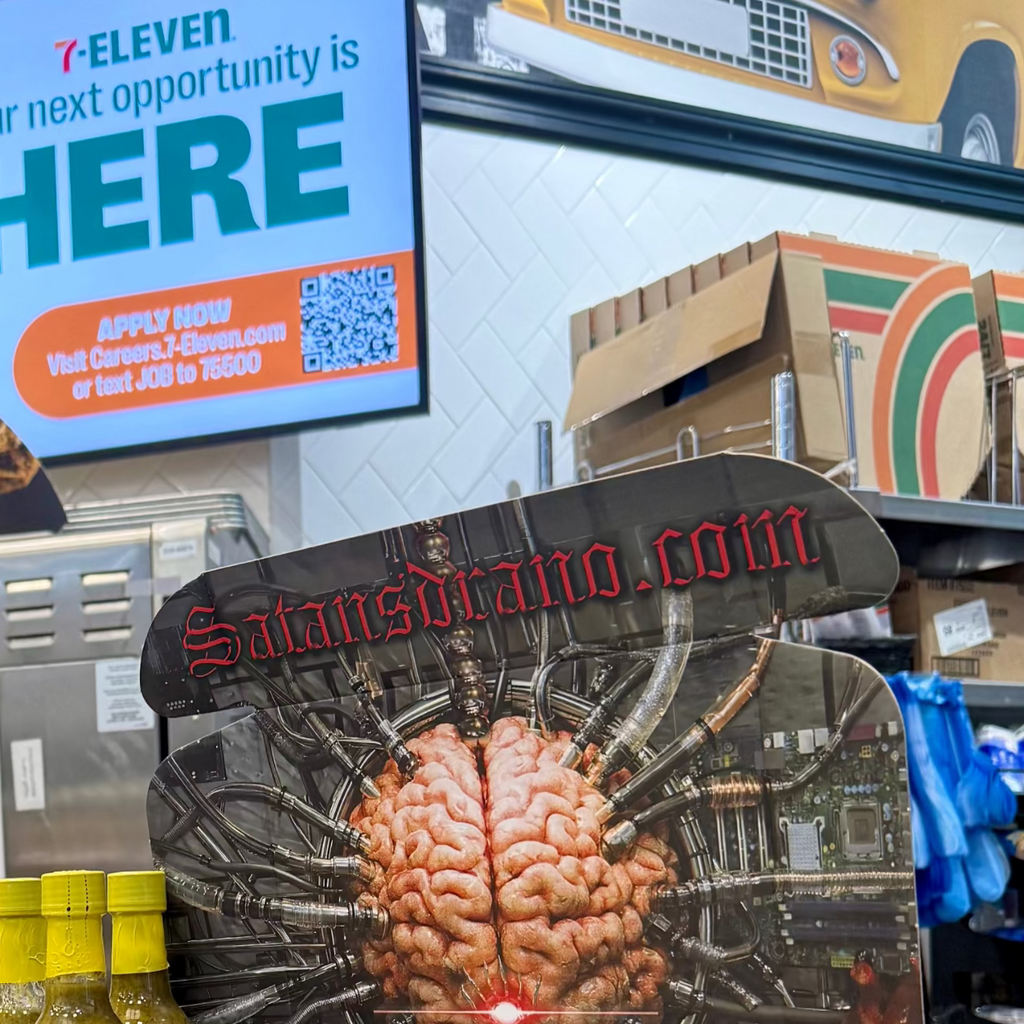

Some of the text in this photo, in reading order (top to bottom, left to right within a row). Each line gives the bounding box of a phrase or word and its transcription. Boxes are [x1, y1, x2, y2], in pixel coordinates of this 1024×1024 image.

[28, 83, 102, 128] next
[112, 44, 320, 118] opportunity
[330, 34, 360, 72] is
[97, 298, 232, 342] APPLY NOW
[47, 321, 287, 376] Visit Careers.7-Eleven.com
[72, 351, 262, 400] or text JOB to 75500
[182, 503, 822, 679] Satansdrano.com
